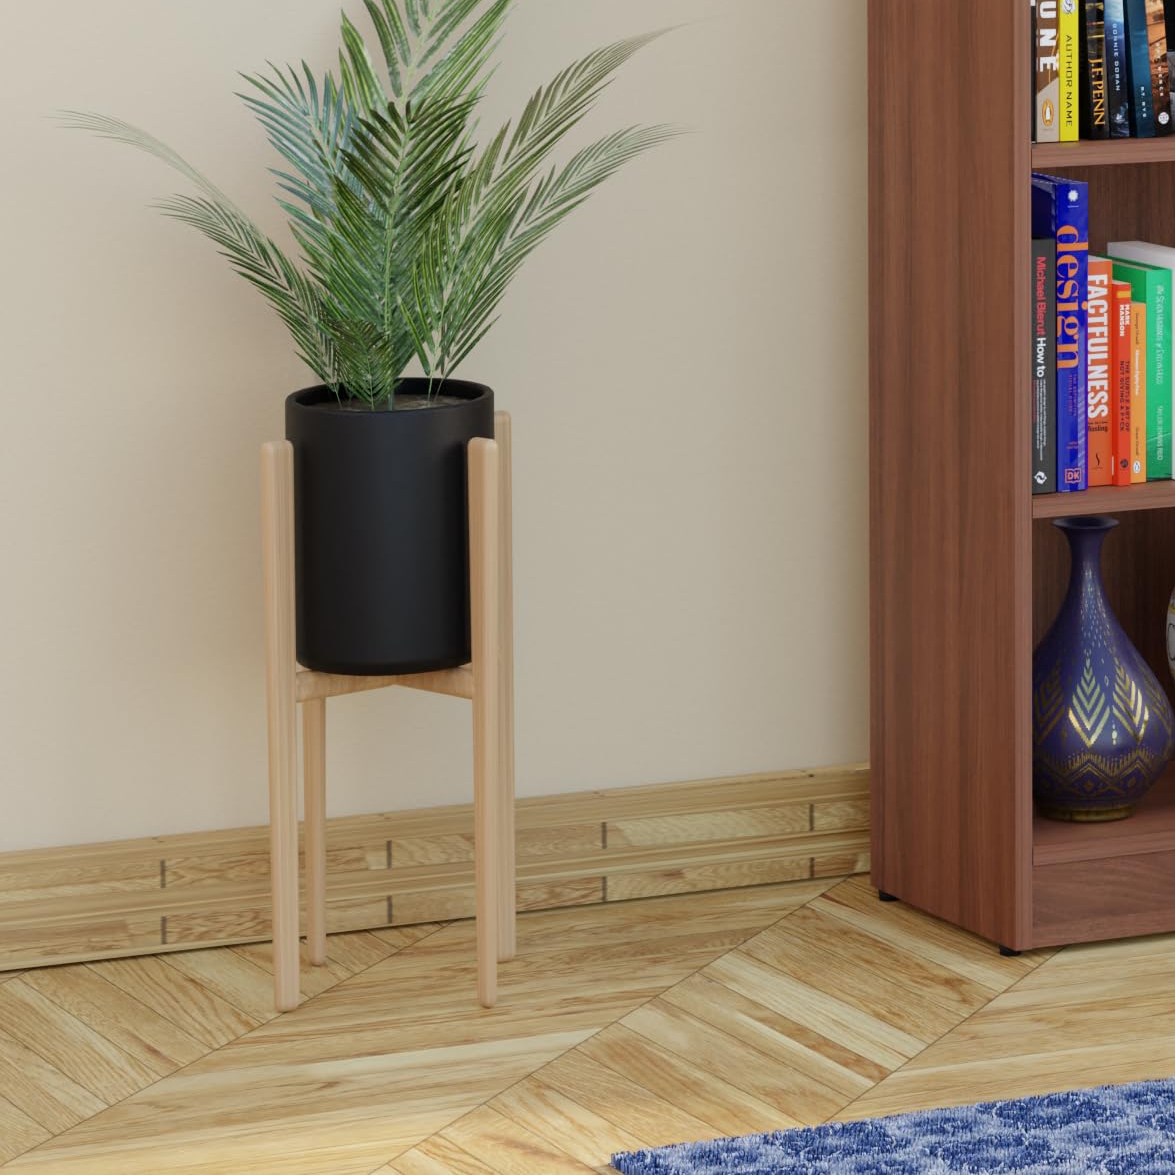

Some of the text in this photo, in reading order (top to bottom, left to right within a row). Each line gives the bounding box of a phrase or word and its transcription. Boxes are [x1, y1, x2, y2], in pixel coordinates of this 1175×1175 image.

[1065, 34, 1073, 127] AUTHOR NAME
[1088, 57, 1105, 126] J.F. PENN
[1036, 256, 1047, 300] Michael
[1057, 225, 1088, 369] design
[1036, 301, 1047, 336] Bierut
[1036, 337, 1047, 364] How
[1088, 273, 1109, 419] FACTFULNESS
[1036, 365, 1046, 378] to
[1067, 471, 1080, 480] DK
